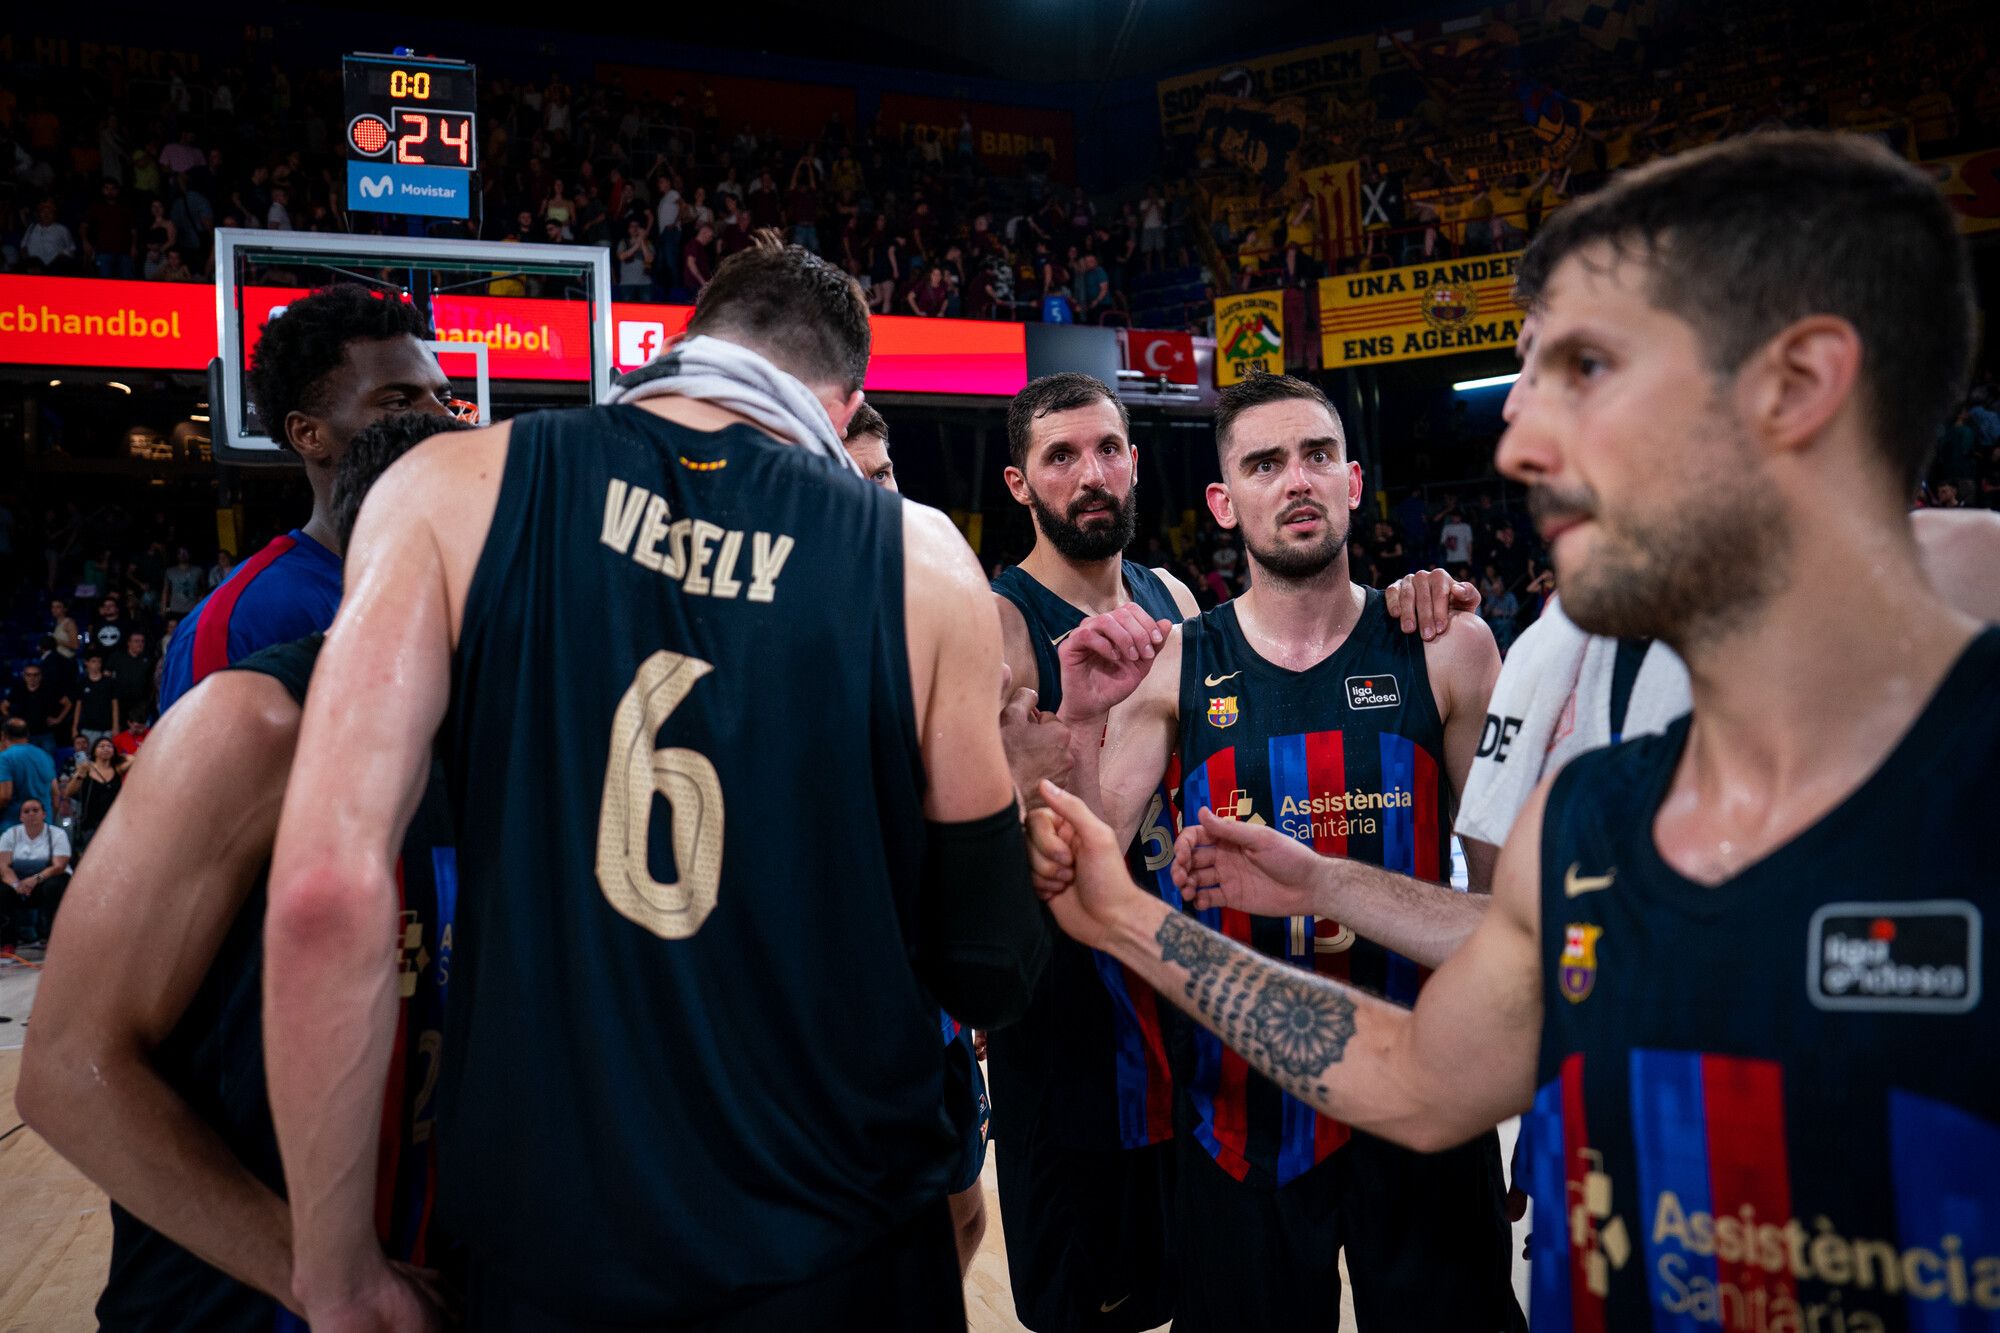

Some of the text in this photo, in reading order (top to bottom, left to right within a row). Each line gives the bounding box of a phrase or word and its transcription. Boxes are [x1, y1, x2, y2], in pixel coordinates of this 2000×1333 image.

[390, 70, 430, 99] 0:0
[398, 114, 469, 165] 24
[401, 183, 457, 198] Movistar
[1347, 273, 1406, 299] UNA
[1343, 319, 1523, 360] ENS AGERMA
[600, 477, 796, 603] VESELY
[1352, 686, 1373, 697] liga
[1354, 694, 1397, 705] endesa
[594, 648, 726, 940] 6
[1280, 786, 1412, 817] Assistència
[1282, 813, 1377, 840] Sanitària
[1652, 1189, 2000, 1310] Assistència
